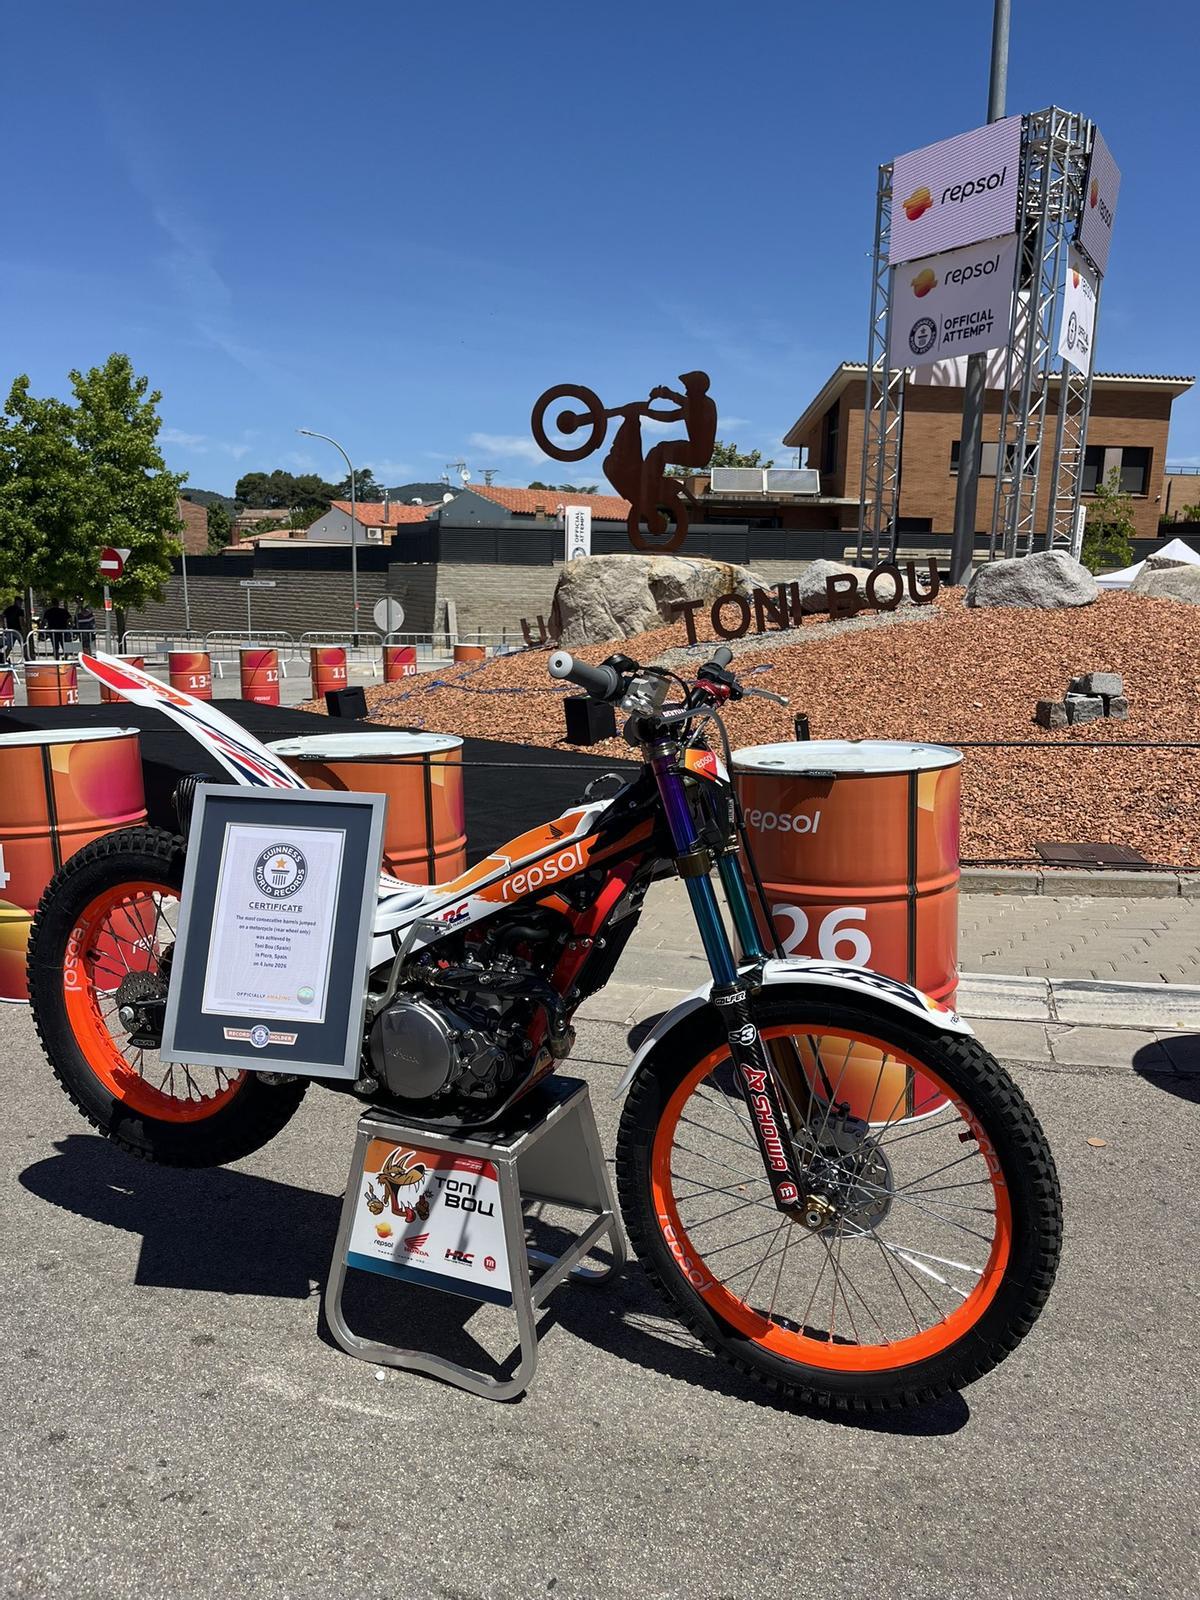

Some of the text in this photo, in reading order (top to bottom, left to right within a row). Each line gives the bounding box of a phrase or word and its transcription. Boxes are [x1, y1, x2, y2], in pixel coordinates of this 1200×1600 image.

[941, 167, 1007, 204] repsol
[944, 255, 1000, 286] repsol
[944, 308, 994, 330] OFFICIAL
[942, 322, 994, 343] ATTEMPT
[669, 557, 939, 646] TONI BOU
[266, 669, 279, 682] 12
[332, 667, 346, 679] 11
[402, 665, 416, 676] 10
[189, 675, 206, 689] 13
[744, 808, 821, 834] repsol
[262, 846, 302, 863] GUINNESS
[256, 866, 305, 896] WORLD RECORDS
[501, 843, 584, 899] repsol
[249, 901, 303, 912] CERTIFICATE
[771, 903, 872, 967] 26
[64, 915, 90, 993] repsol
[236, 991, 266, 999] OFFICIALLY
[228, 1030, 250, 1038] RECORD
[752, 1094, 788, 1172] SHOWA
[435, 1176, 477, 1196] TONI
[444, 1192, 495, 1217] BOU
[374, 1239, 394, 1248] repsol
[404, 1247, 430, 1257] HONDA
[658, 1214, 714, 1293] repsol
[444, 1248, 475, 1265] HRC
